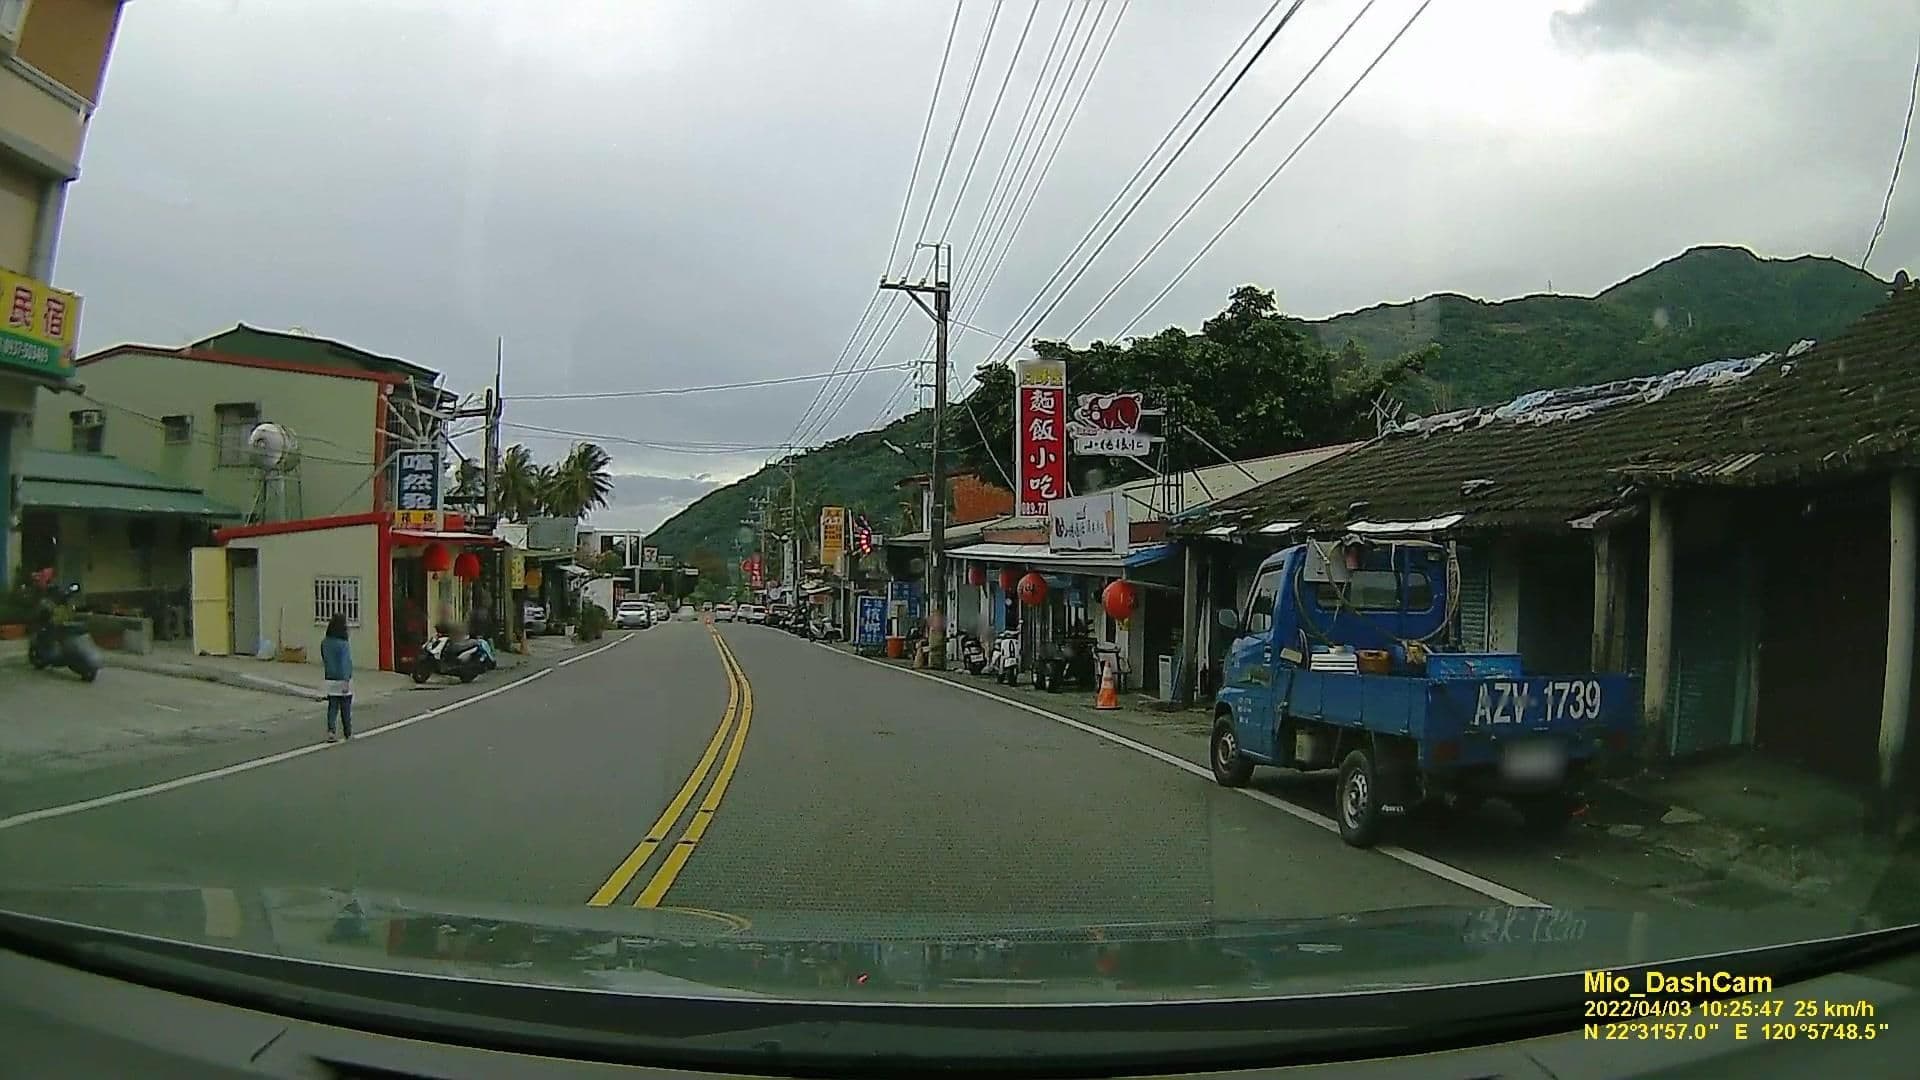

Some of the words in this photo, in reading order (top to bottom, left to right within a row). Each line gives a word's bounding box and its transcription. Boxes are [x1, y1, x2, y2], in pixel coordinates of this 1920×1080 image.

[1029, 390, 1058, 499] 麵飯小吃
[1544, 680, 1601, 721] 1739
